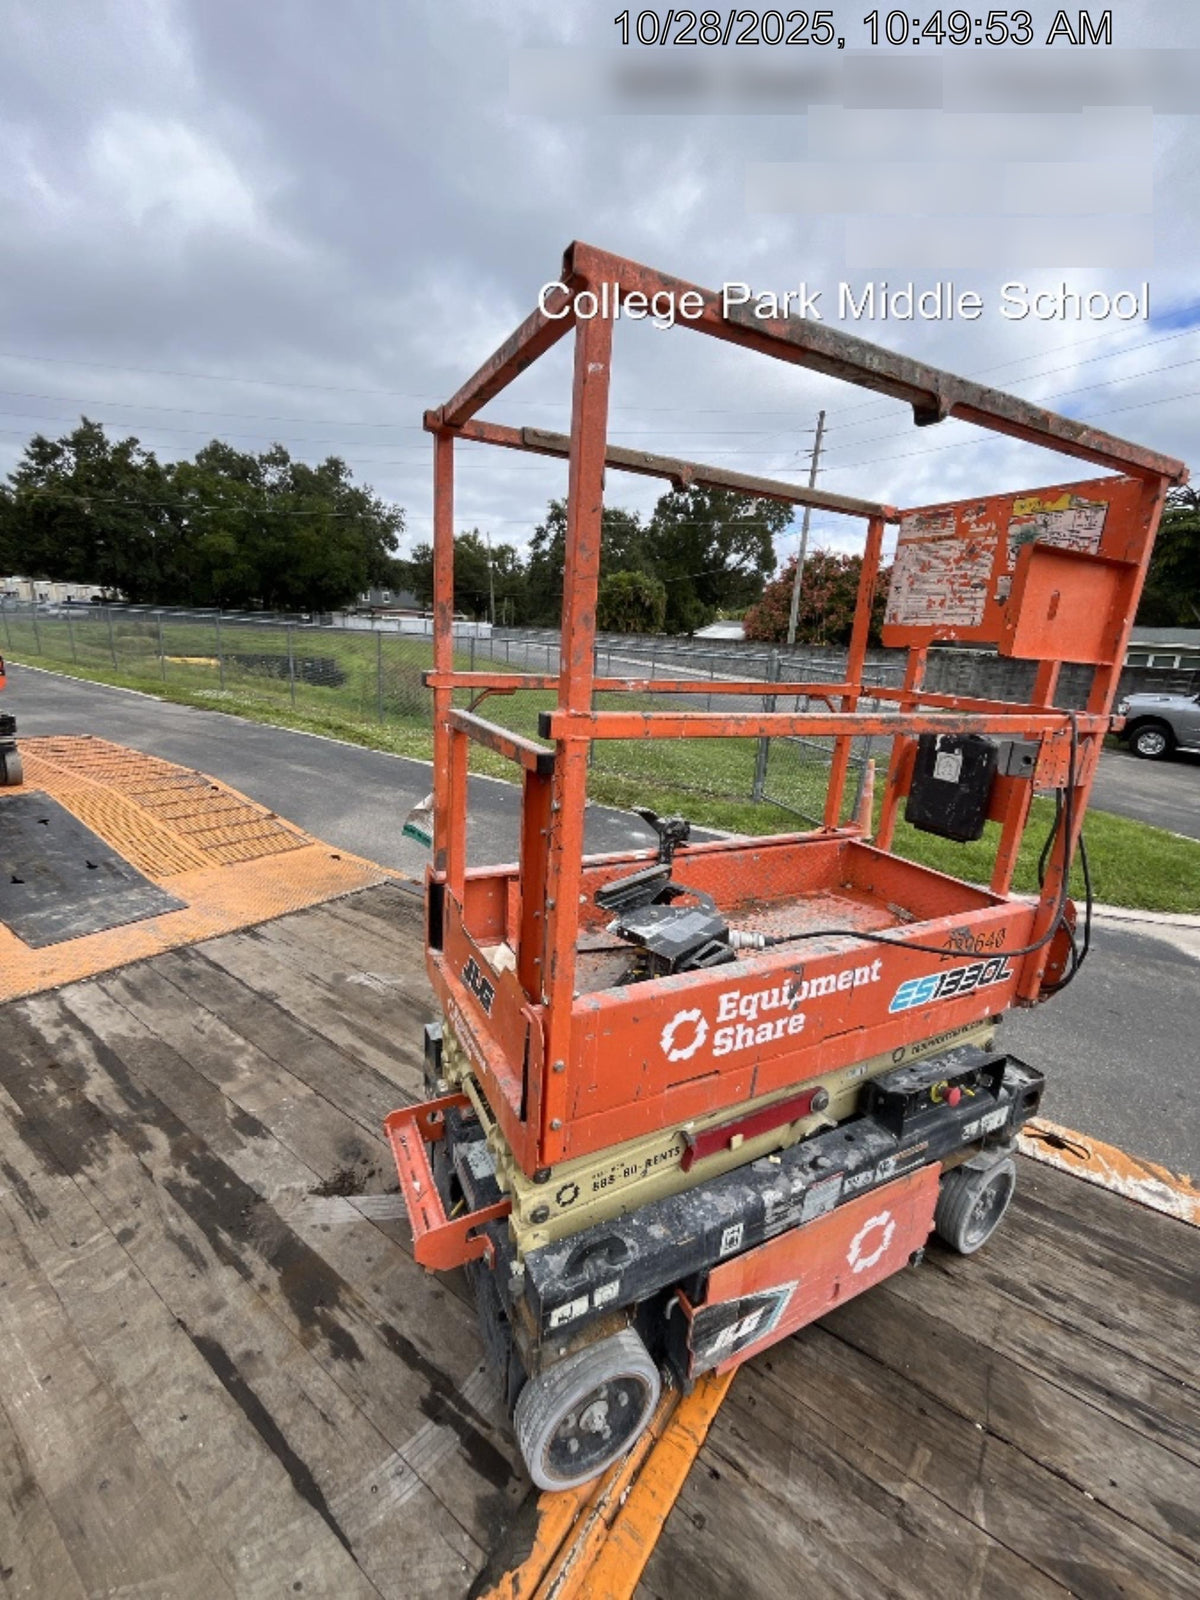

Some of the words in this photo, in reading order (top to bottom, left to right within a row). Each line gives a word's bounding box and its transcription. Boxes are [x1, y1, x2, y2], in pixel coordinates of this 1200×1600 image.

[716, 958, 883, 1023] Equipment
[889, 955, 1014, 1014] ES1330L
[712, 1012, 806, 1057] Share
